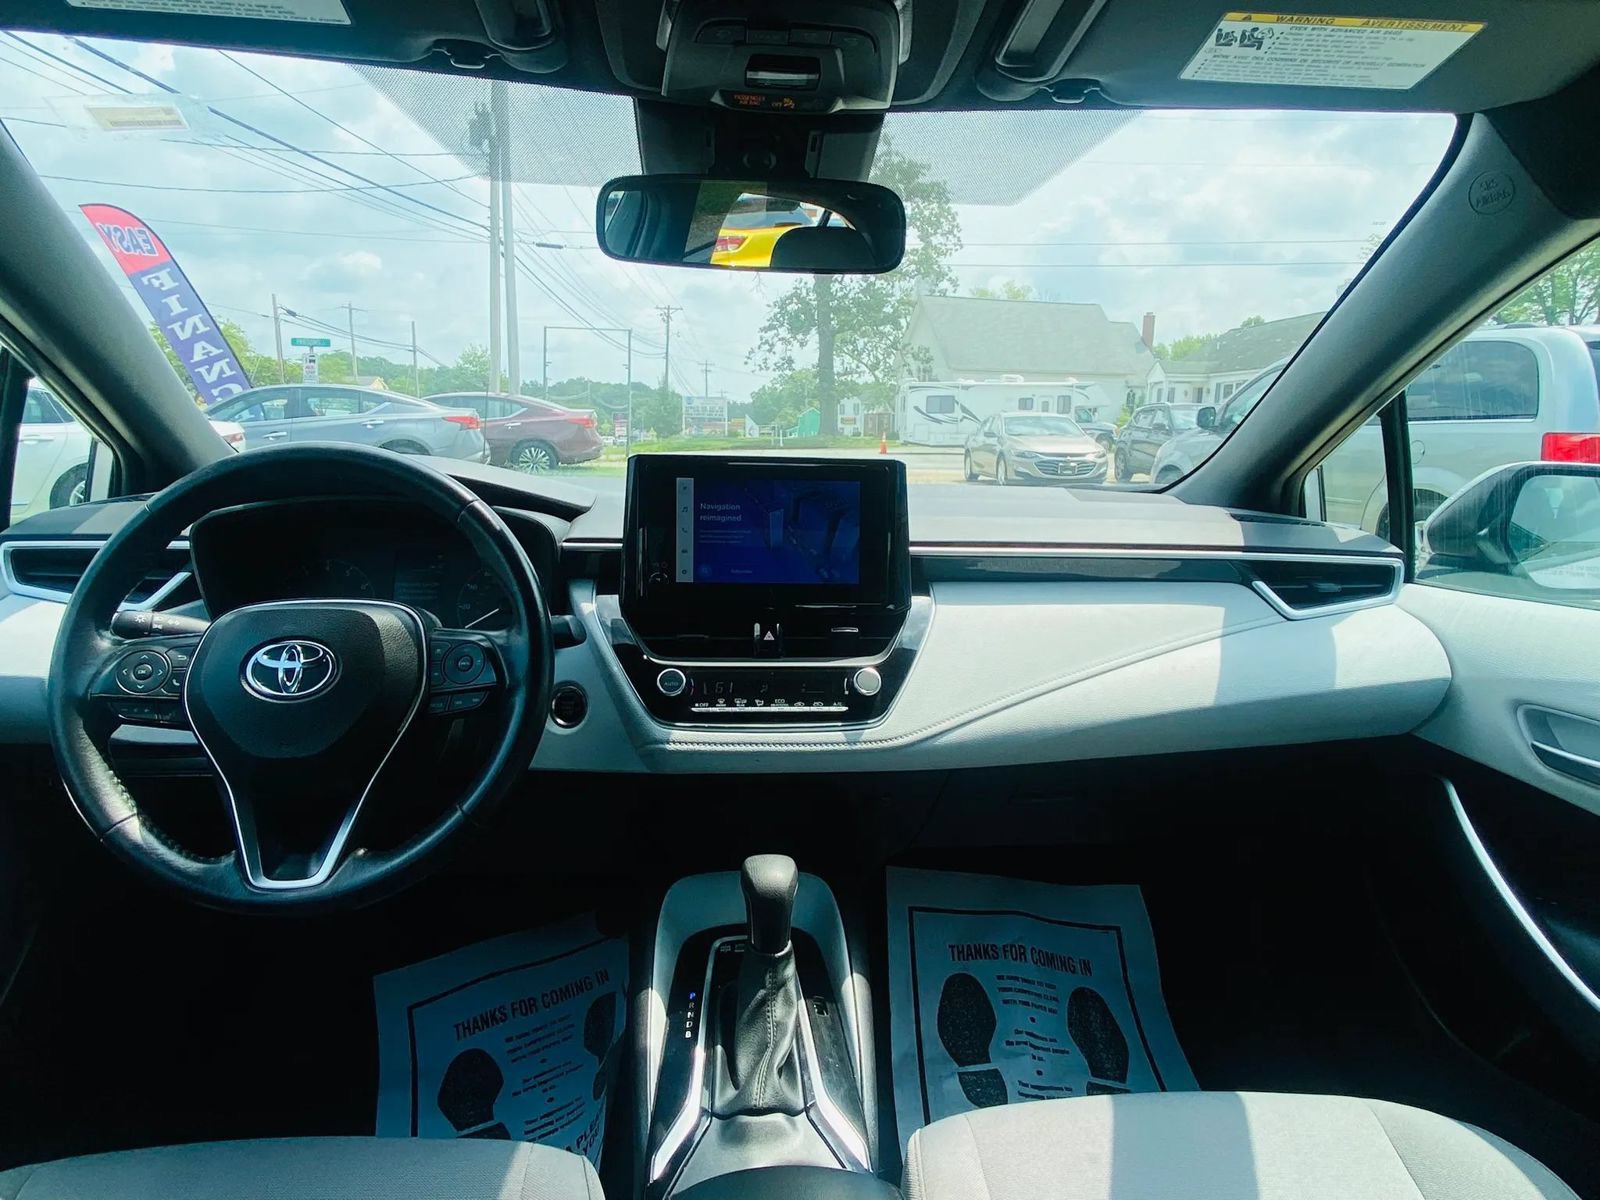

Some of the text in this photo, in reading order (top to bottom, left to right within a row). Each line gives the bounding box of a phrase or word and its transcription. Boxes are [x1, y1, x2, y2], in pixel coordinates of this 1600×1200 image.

[1276, 15, 1468, 31] WARNING AVERTISSEMENT
[700, 503, 741, 511] Navigation
[699, 514, 742, 523] reimagined
[948, 943, 1093, 977] THANKS FOR COMING IN
[454, 1005, 508, 1041] THANKS
[511, 997, 539, 1020] FOR
[541, 975, 593, 1009] COMING
[595, 968, 609, 985] IN
